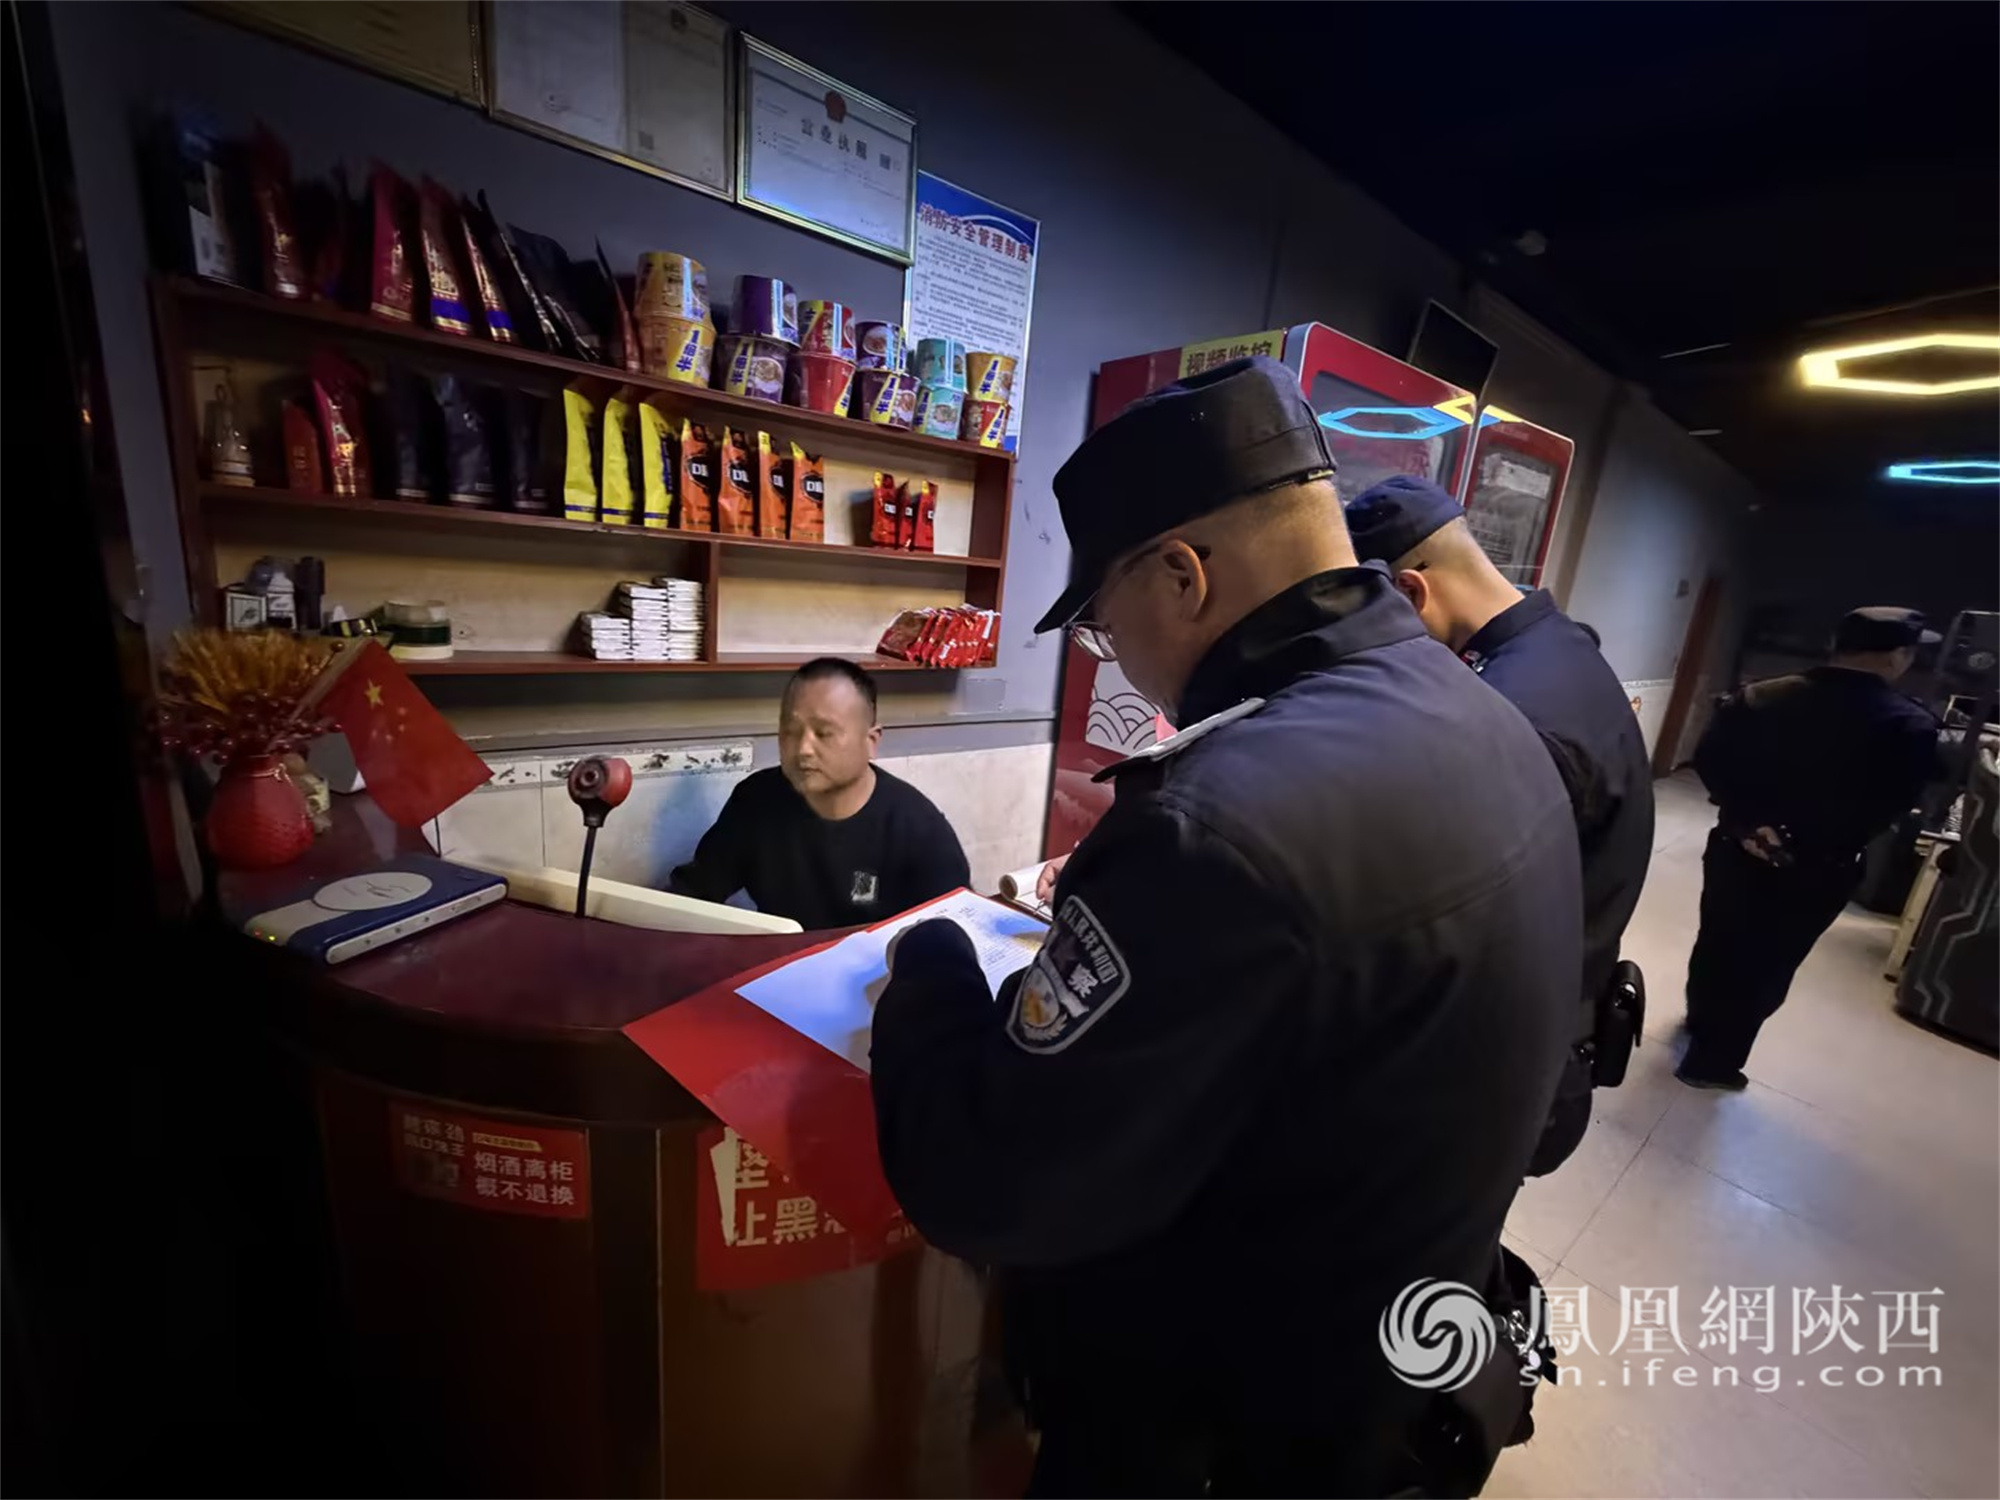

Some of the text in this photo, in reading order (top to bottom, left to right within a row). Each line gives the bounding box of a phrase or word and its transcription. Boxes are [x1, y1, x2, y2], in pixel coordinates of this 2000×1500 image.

[919, 202, 1030, 263] 消防安全管理制度
[473, 1150, 575, 1182] 烟酒离柜
[475, 1175, 576, 1206] 概不退换
